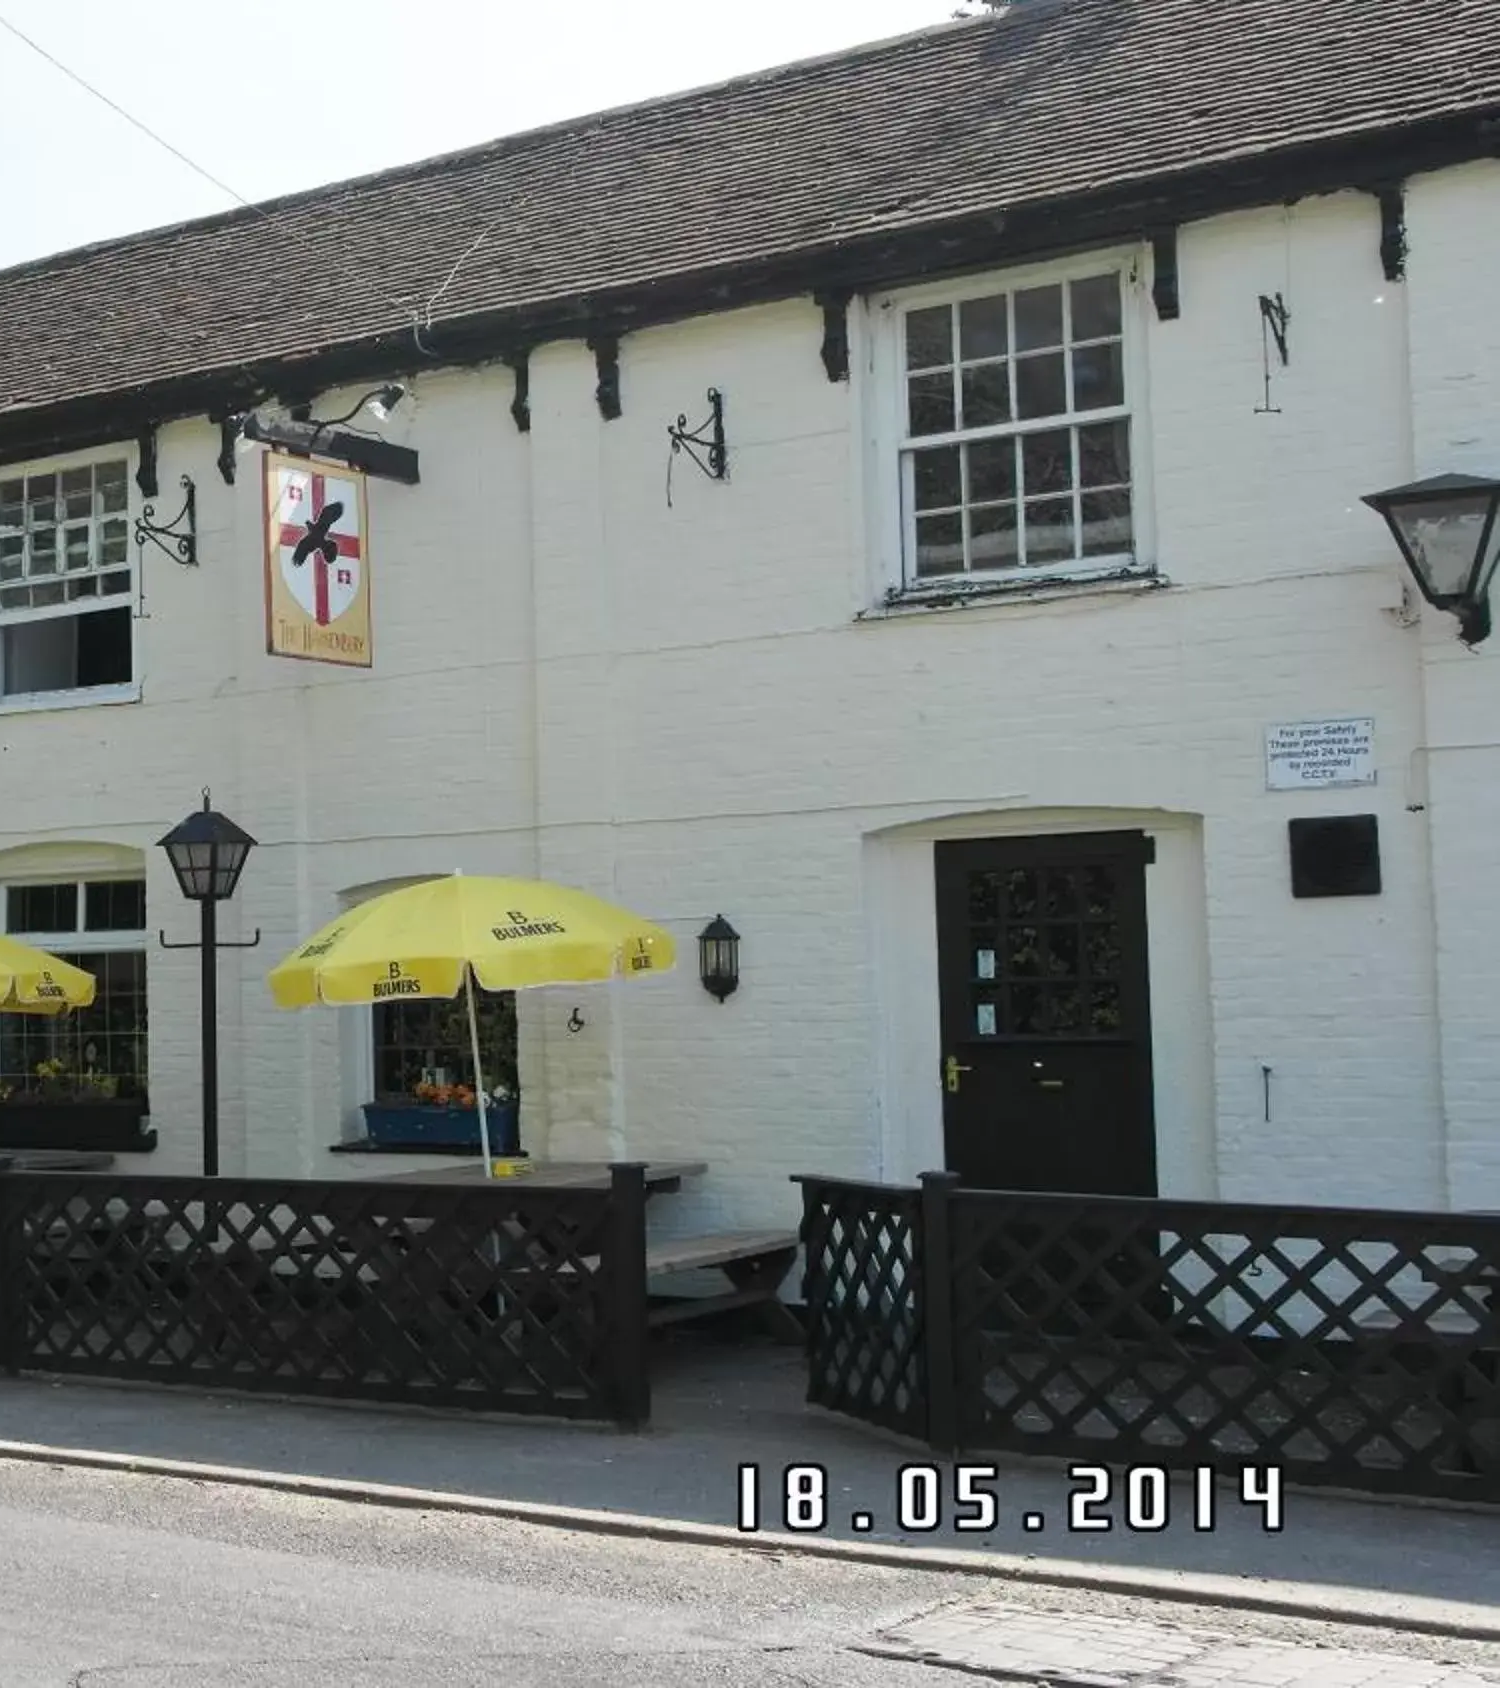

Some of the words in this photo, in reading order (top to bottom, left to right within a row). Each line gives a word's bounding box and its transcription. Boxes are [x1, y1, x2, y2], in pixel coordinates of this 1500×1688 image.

[1321, 747, 1334, 757] 24
[506, 911, 528, 925] B
[491, 921, 566, 941] BULMERS
[389, 961, 401, 979] B
[373, 979, 421, 997] BULMERS
